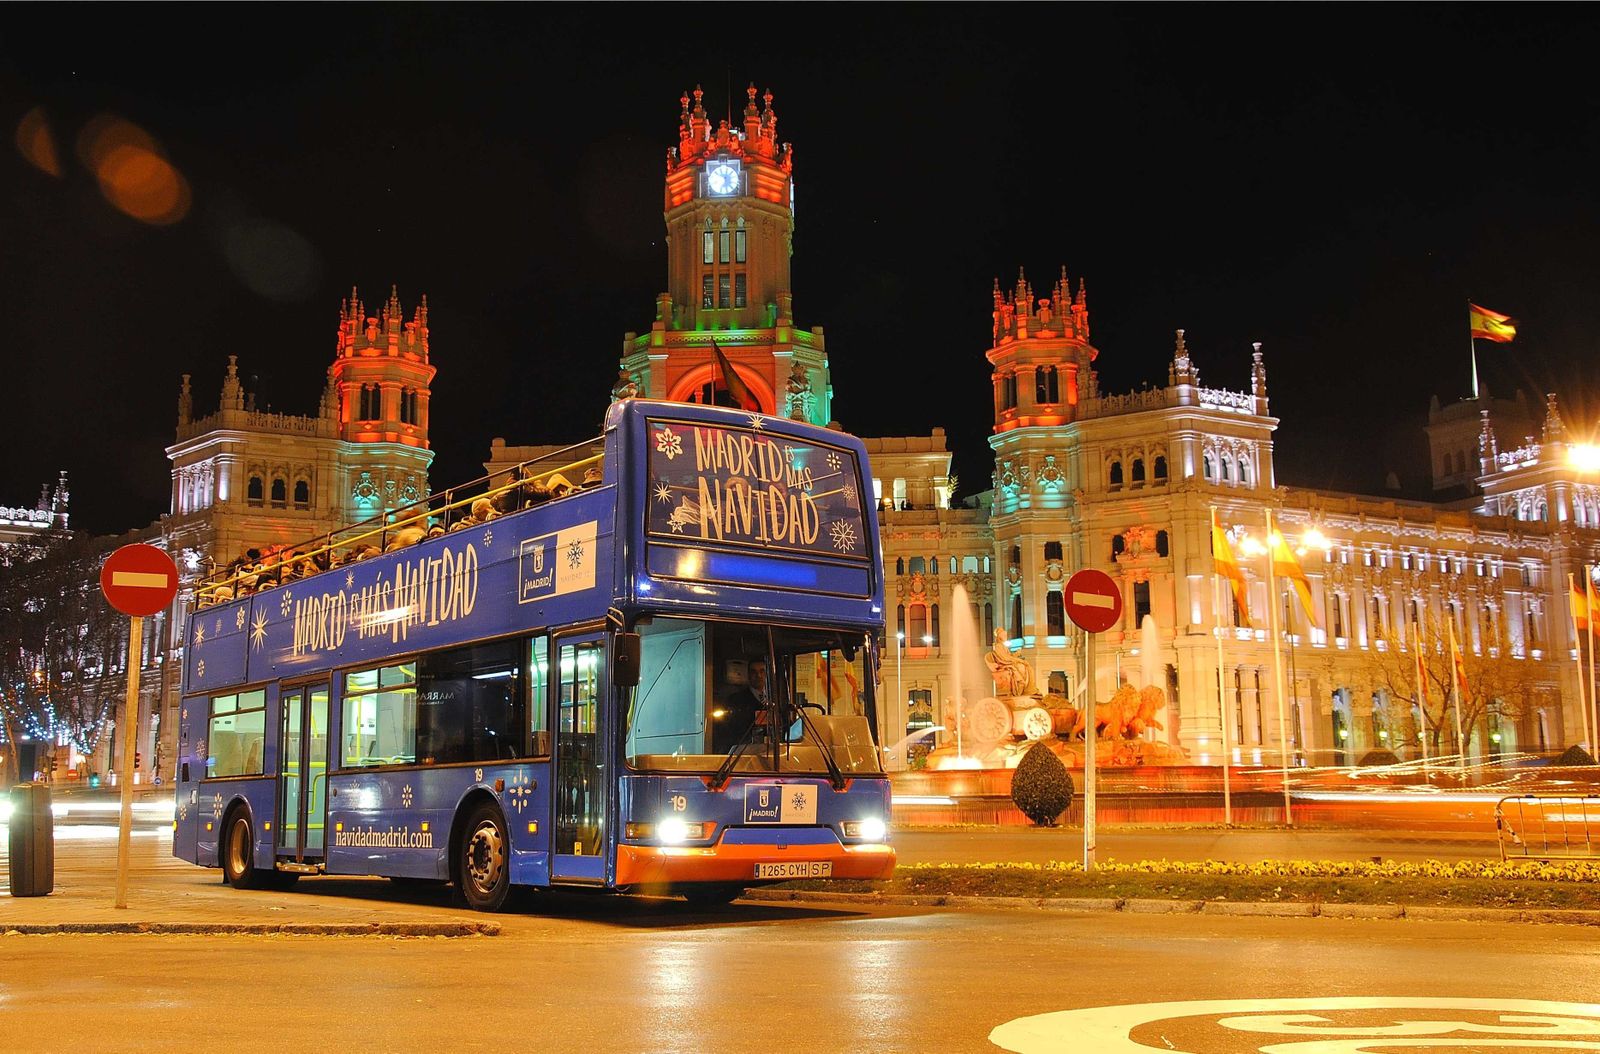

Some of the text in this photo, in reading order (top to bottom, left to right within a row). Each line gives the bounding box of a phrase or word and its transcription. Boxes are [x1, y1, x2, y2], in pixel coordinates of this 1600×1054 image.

[694, 427, 795, 481] MADRID ES
[699, 477, 819, 545] NAVIDAD
[294, 543, 478, 657] MADRID ES MÁS NAVIDAD
[475, 768, 482, 782] 19
[671, 795, 686, 811] 19
[335, 826, 433, 848] navidadmadrid.com
[762, 864, 786, 877] 1265
[788, 863, 807, 876] CYH
